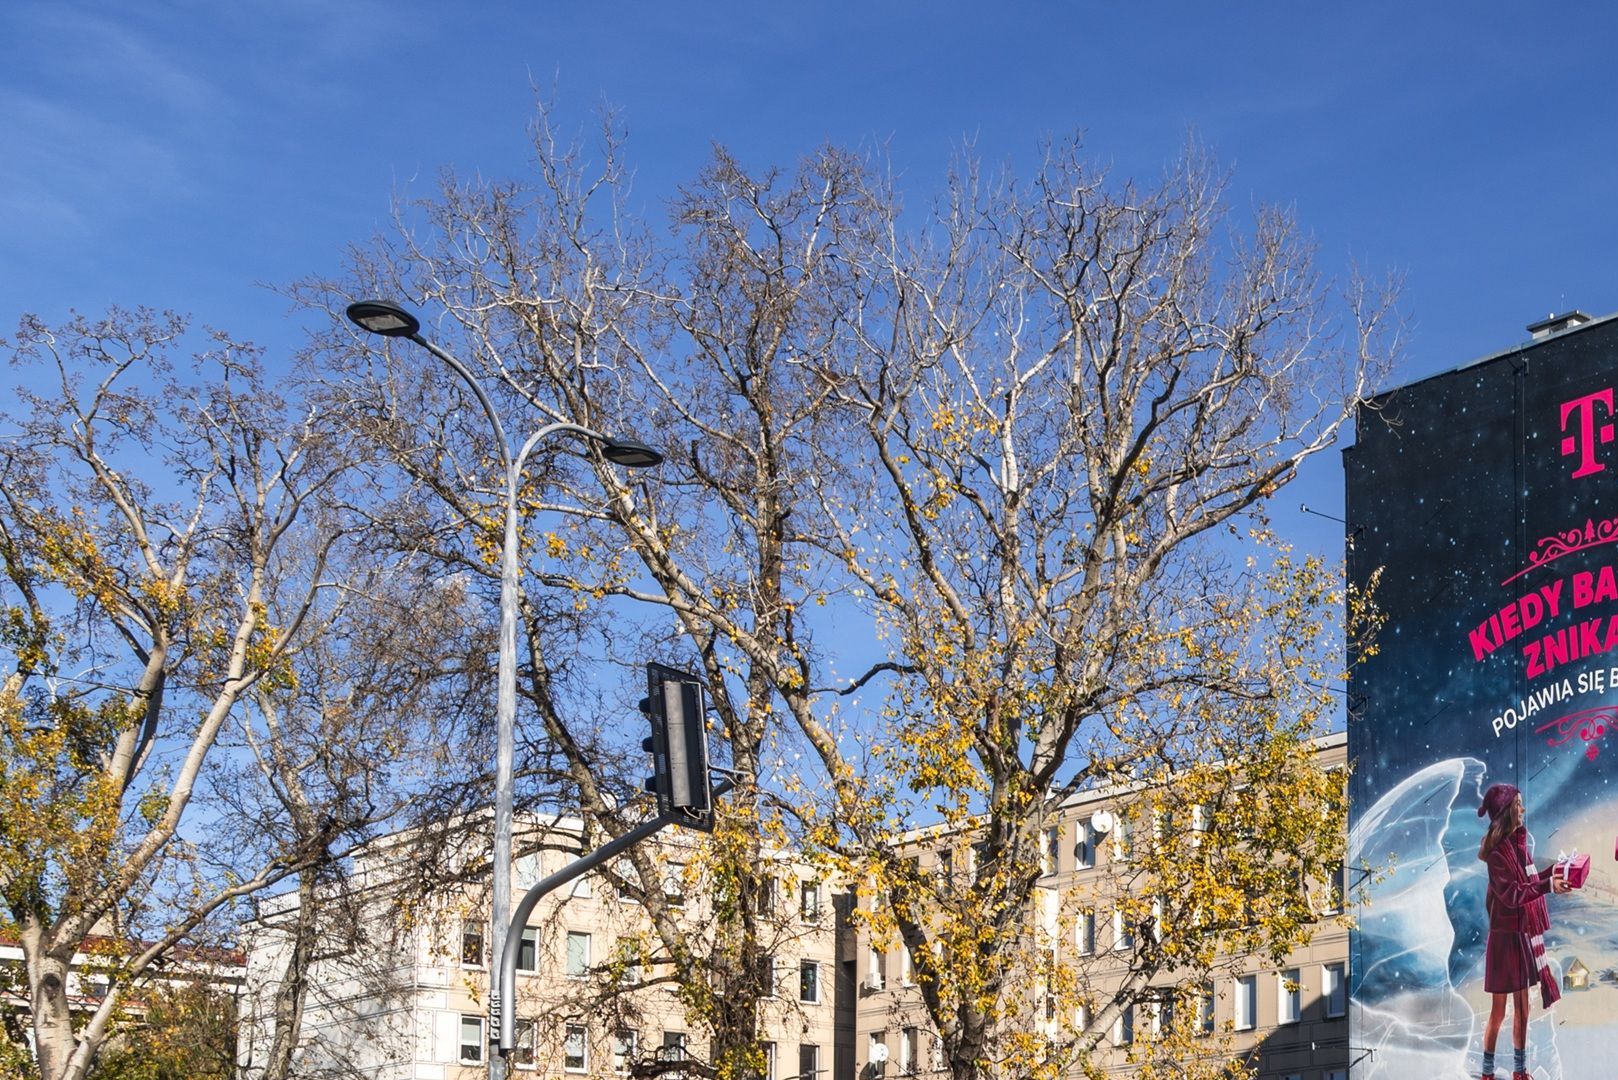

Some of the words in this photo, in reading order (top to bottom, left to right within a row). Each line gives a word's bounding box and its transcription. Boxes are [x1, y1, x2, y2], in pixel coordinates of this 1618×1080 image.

[1468, 579, 1563, 662] KIEDY
[1491, 678, 1574, 738] POJAWIA
[1577, 669, 1605, 694] SIĘ
